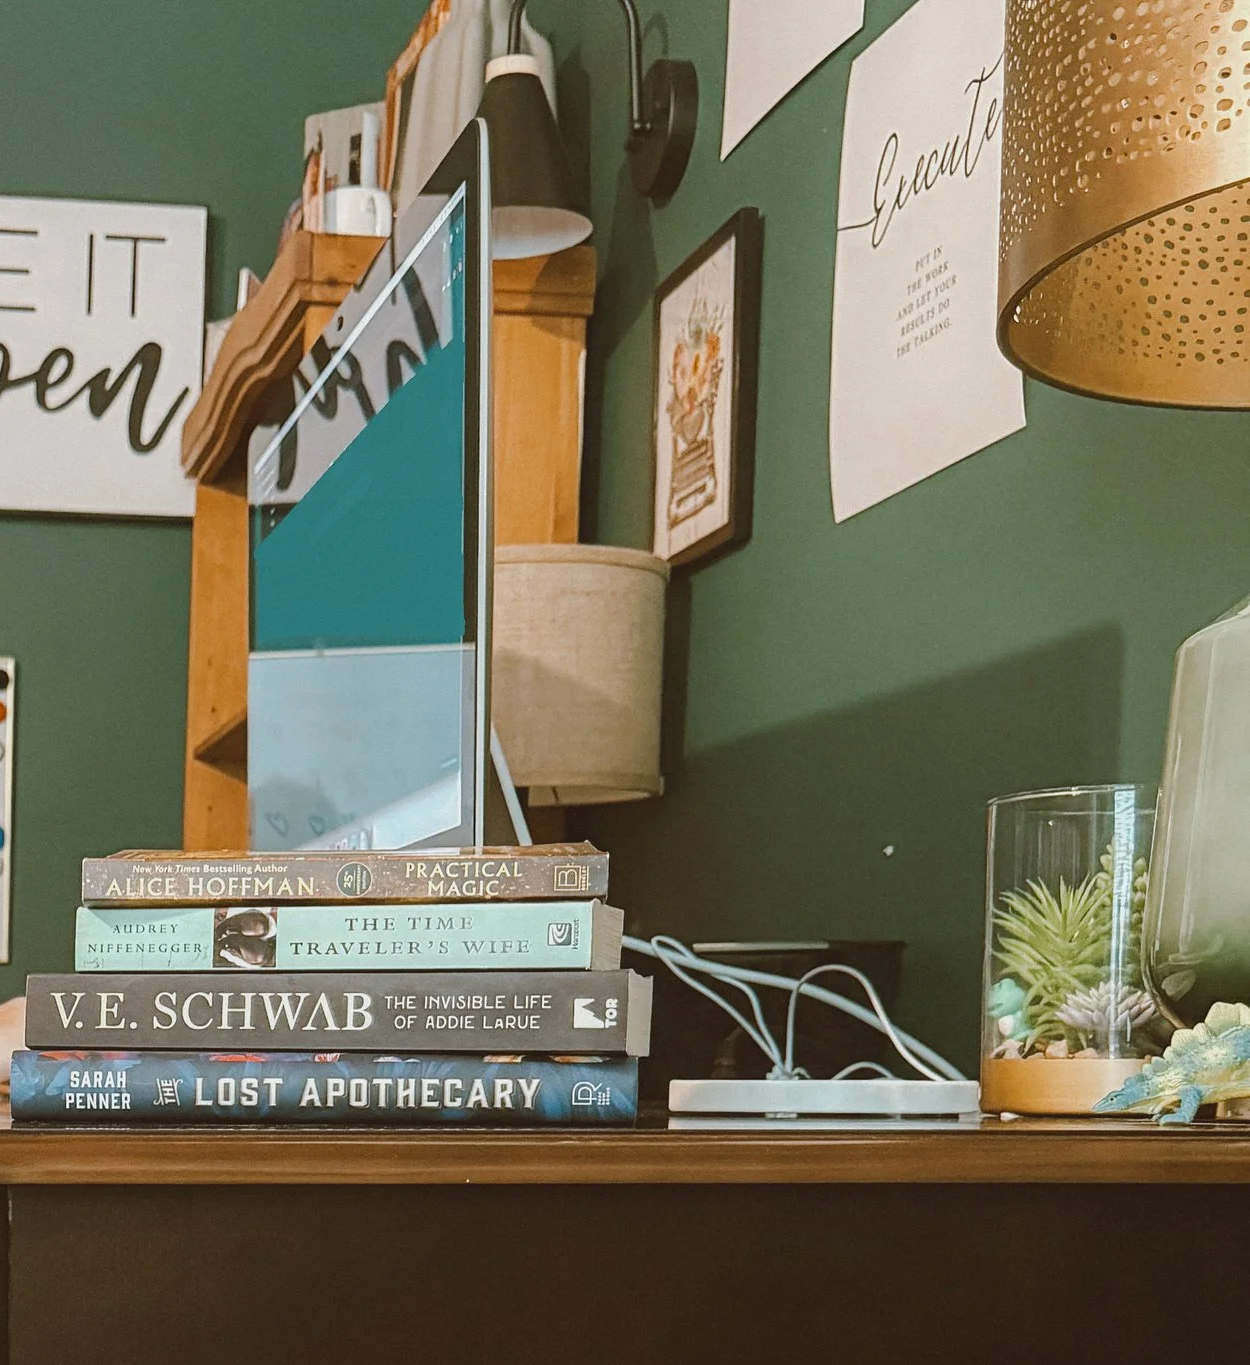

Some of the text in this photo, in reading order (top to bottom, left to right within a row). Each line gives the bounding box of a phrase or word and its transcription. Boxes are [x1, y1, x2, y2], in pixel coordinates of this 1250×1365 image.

[838, 50, 1004, 248] Execute
[84, 231, 167, 319] IT
[906, 260, 949, 297] THE WORK
[895, 301, 915, 321] AND
[916, 290, 931, 310] LET
[937, 297, 951, 315] DO
[896, 341, 911, 359] THE
[133, 863, 289, 876] New York Times Bestselling Author
[405, 861, 523, 879] PRACTICAL
[105, 877, 316, 897] ALICE HOFFMAN
[427, 880, 500, 898] MAGIC
[112, 923, 179, 935] AUDREY
[344, 915, 475, 933] THE TIME
[87, 942, 204, 955] NIFFENEGGER
[290, 938, 531, 956] TRAVELER'S WIFE
[384, 994, 553, 1010] THE INVISIBLE LIFE
[394, 1014, 417, 1029] OF
[425, 1014, 475, 1030] ADDIE
[604, 997, 618, 1029] TOR
[70, 1070, 127, 1089] SARAH
[65, 1093, 131, 1110] PENNER
[161, 1077, 542, 1110] THE LOST APOTHECARY
